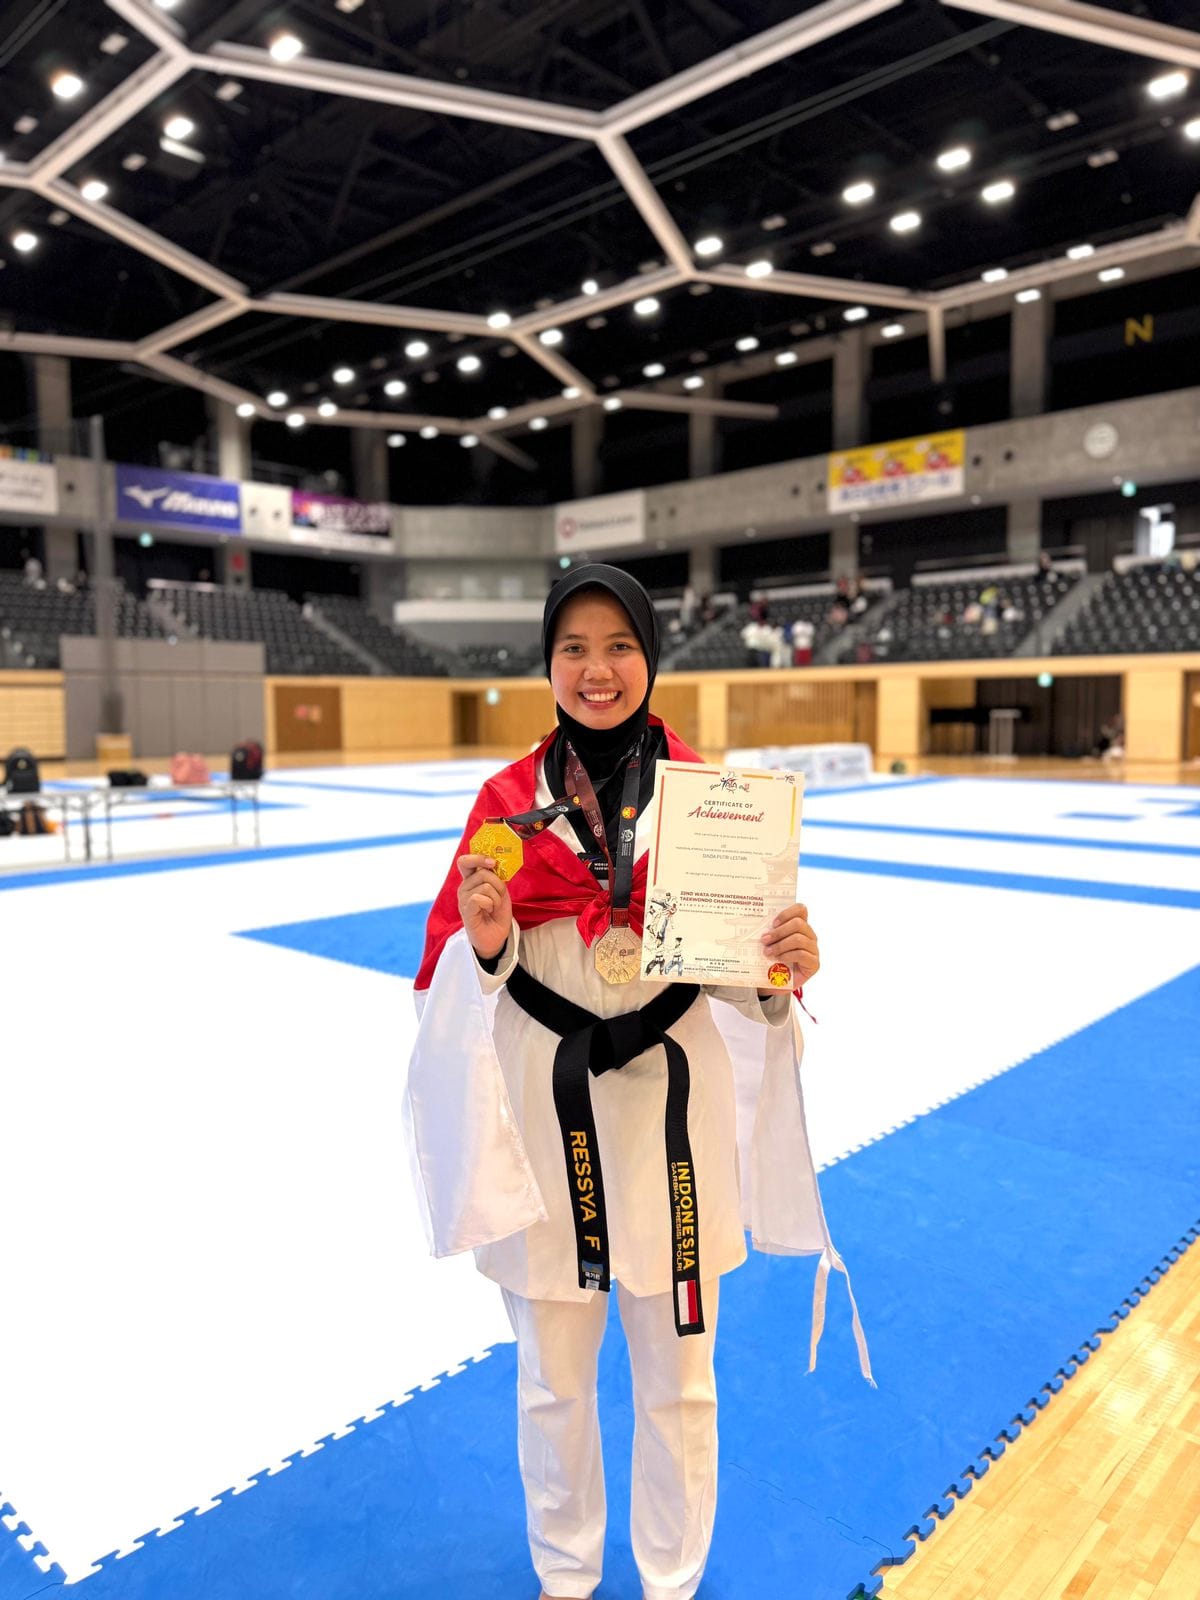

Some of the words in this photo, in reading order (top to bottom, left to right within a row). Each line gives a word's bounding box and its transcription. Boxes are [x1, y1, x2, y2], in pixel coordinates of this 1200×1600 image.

[1125, 313, 1153, 347] N
[687, 805, 765, 823] Achievement
[703, 799, 743, 808] CERTIFICATE
[570, 1131, 597, 1223] RESSYA
[584, 1234, 601, 1251] F
[676, 1161, 696, 1271] INDONESIA
[676, 1243, 684, 1273] POLRI
